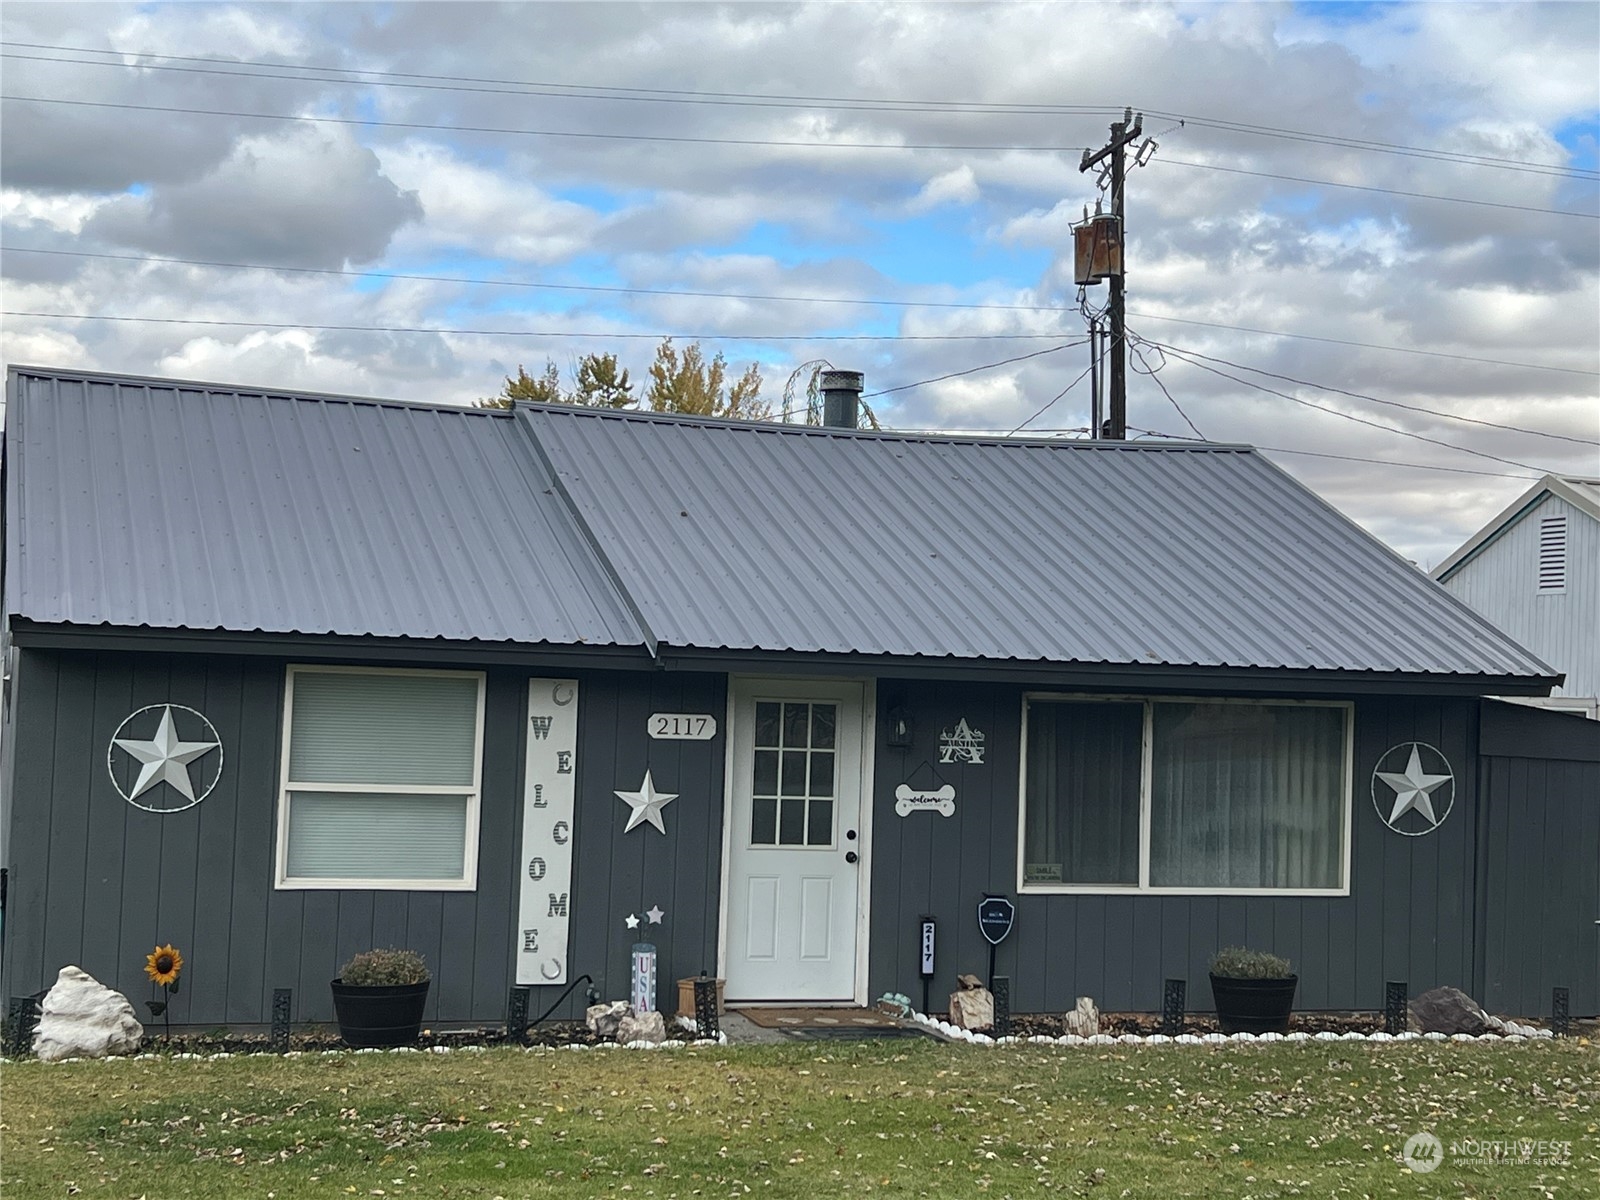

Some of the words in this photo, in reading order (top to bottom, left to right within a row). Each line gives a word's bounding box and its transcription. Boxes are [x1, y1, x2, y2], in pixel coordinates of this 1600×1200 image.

[656, 717, 708, 736] 2117
[523, 716, 572, 953] WELCOME
[924, 925, 933, 962] 2117
[639, 956, 649, 1012] USA
